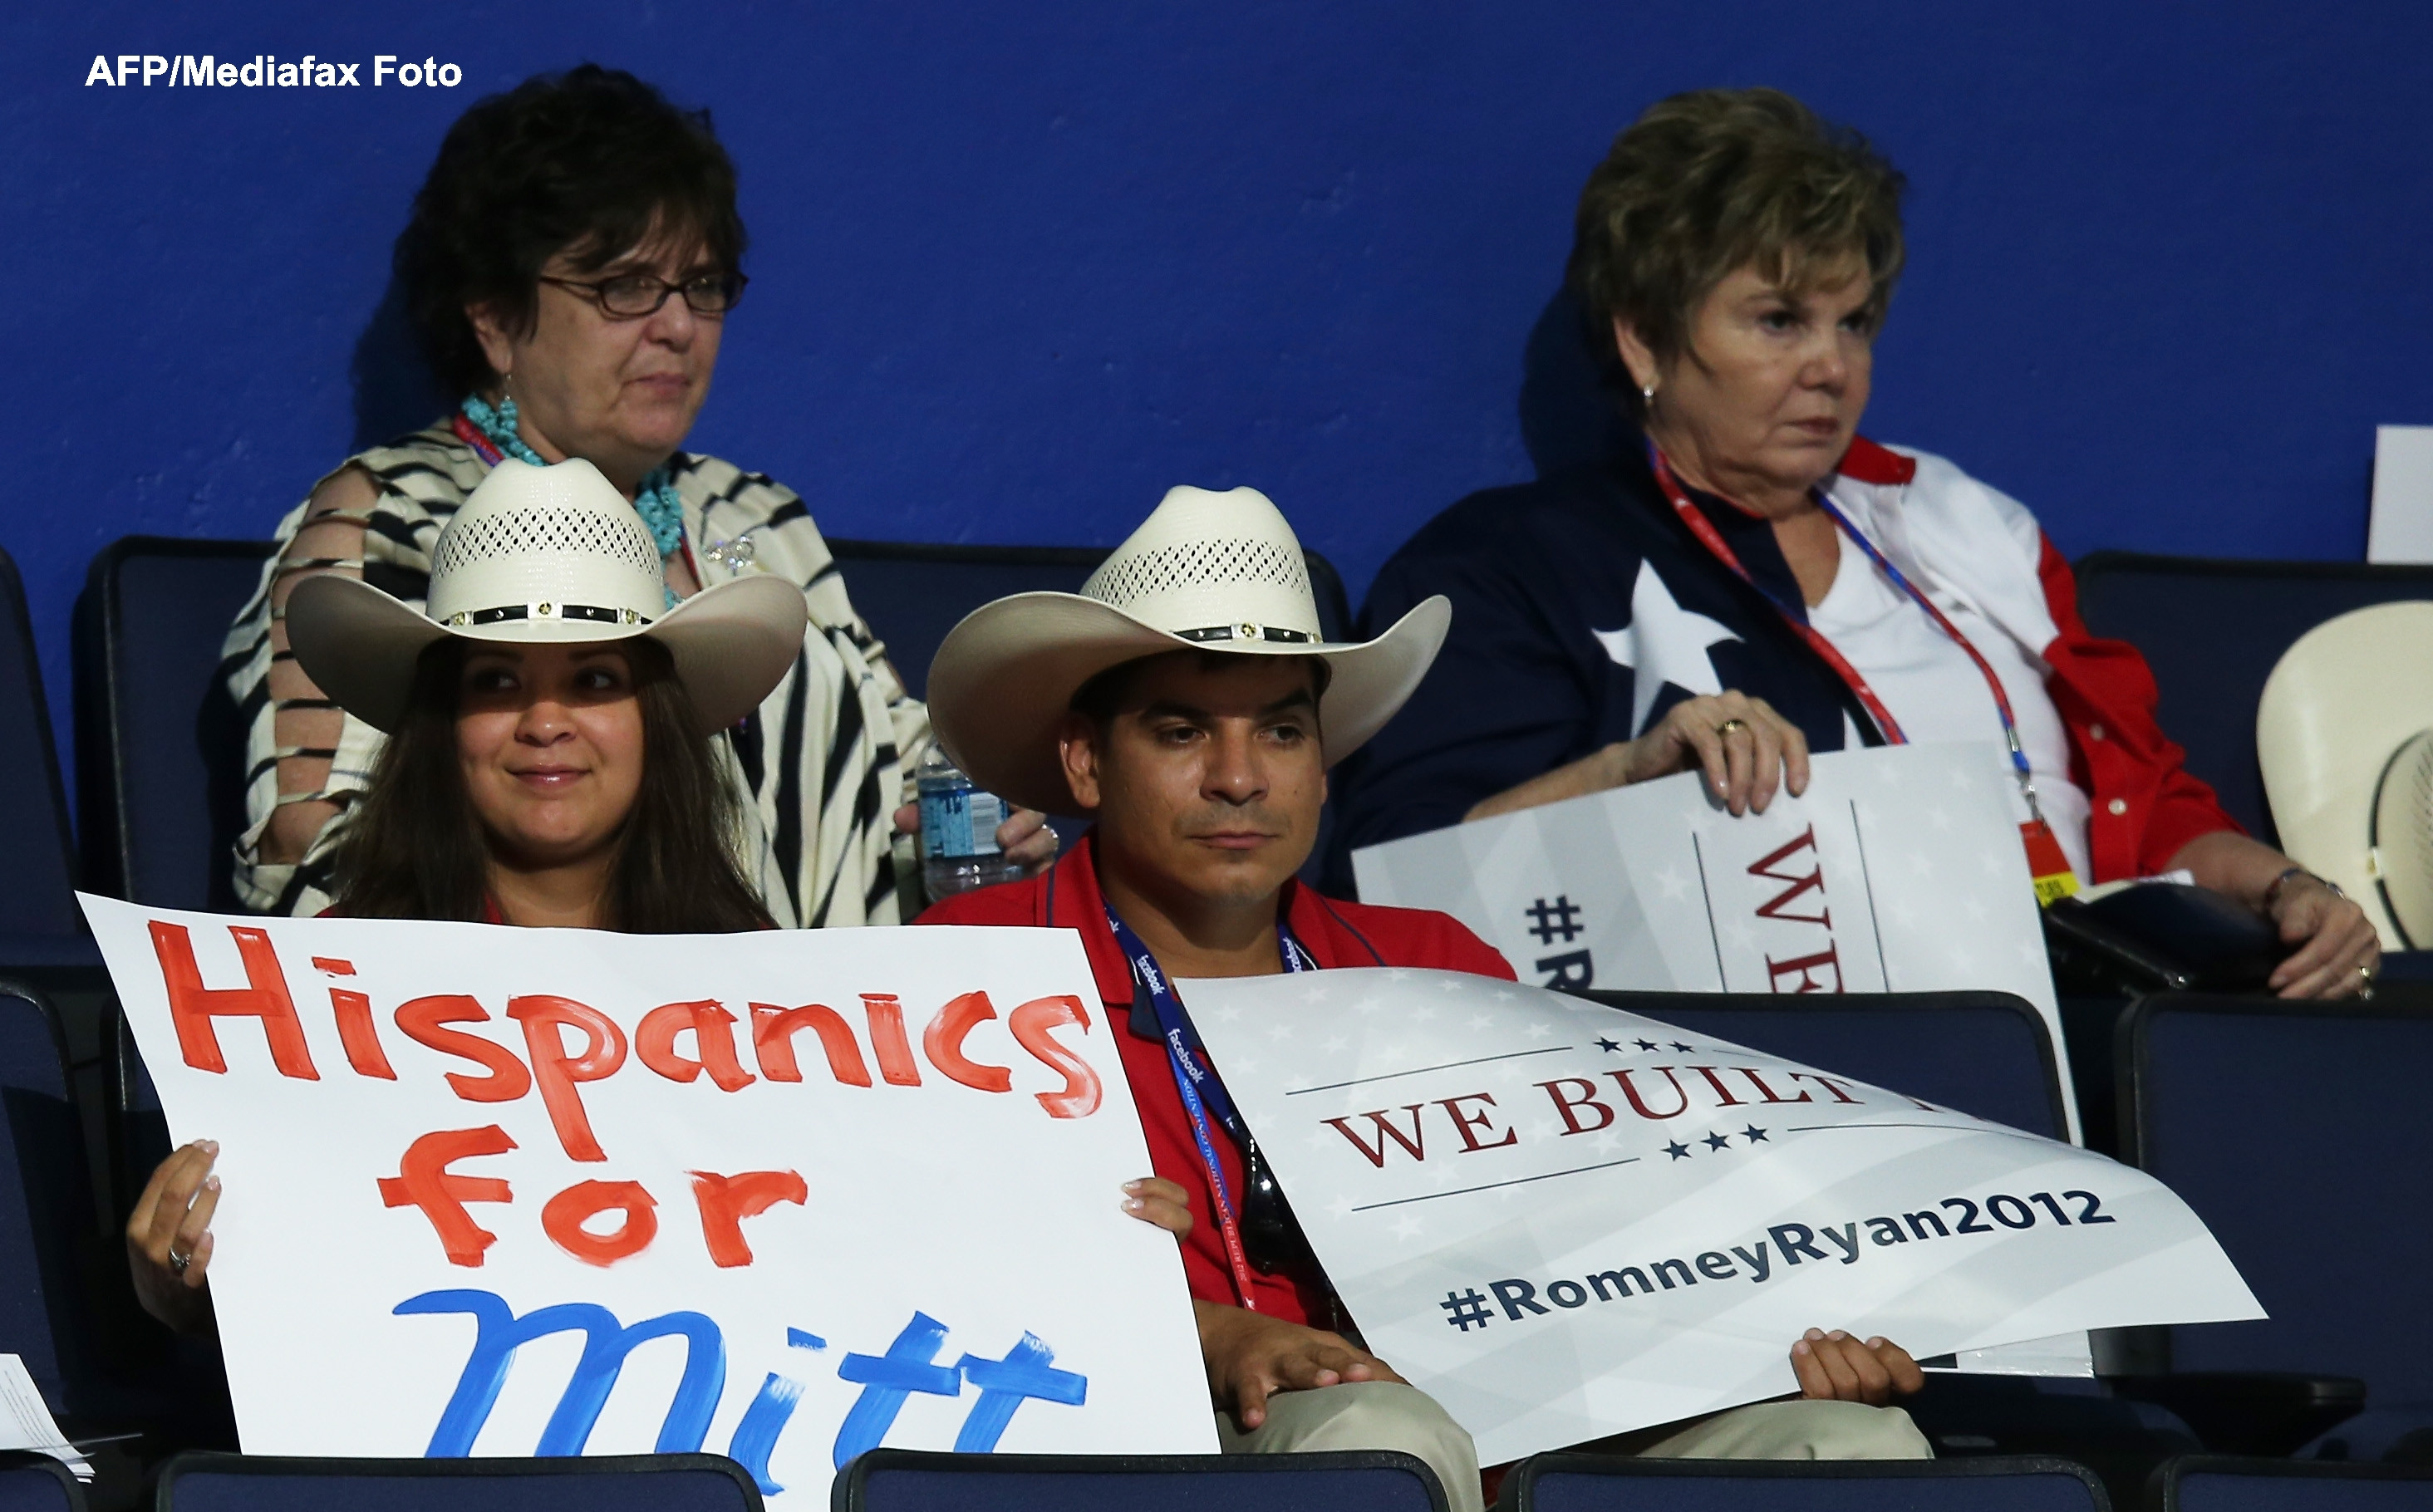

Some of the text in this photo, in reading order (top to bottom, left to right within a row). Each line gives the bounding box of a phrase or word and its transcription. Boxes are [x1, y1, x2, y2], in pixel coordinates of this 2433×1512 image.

[1136, 955, 1165, 995] facebook
[1747, 822, 1845, 994] WE
[148, 920, 1103, 1162] Hispanics
[1167, 1028, 1204, 1083] facebook
[1320, 1065, 1865, 1169] WE BUILT
[377, 1124, 809, 1268] for
[1439, 1190, 2116, 1332] #RomneyRyan2012
[392, 1289, 1088, 1497] Mitt
